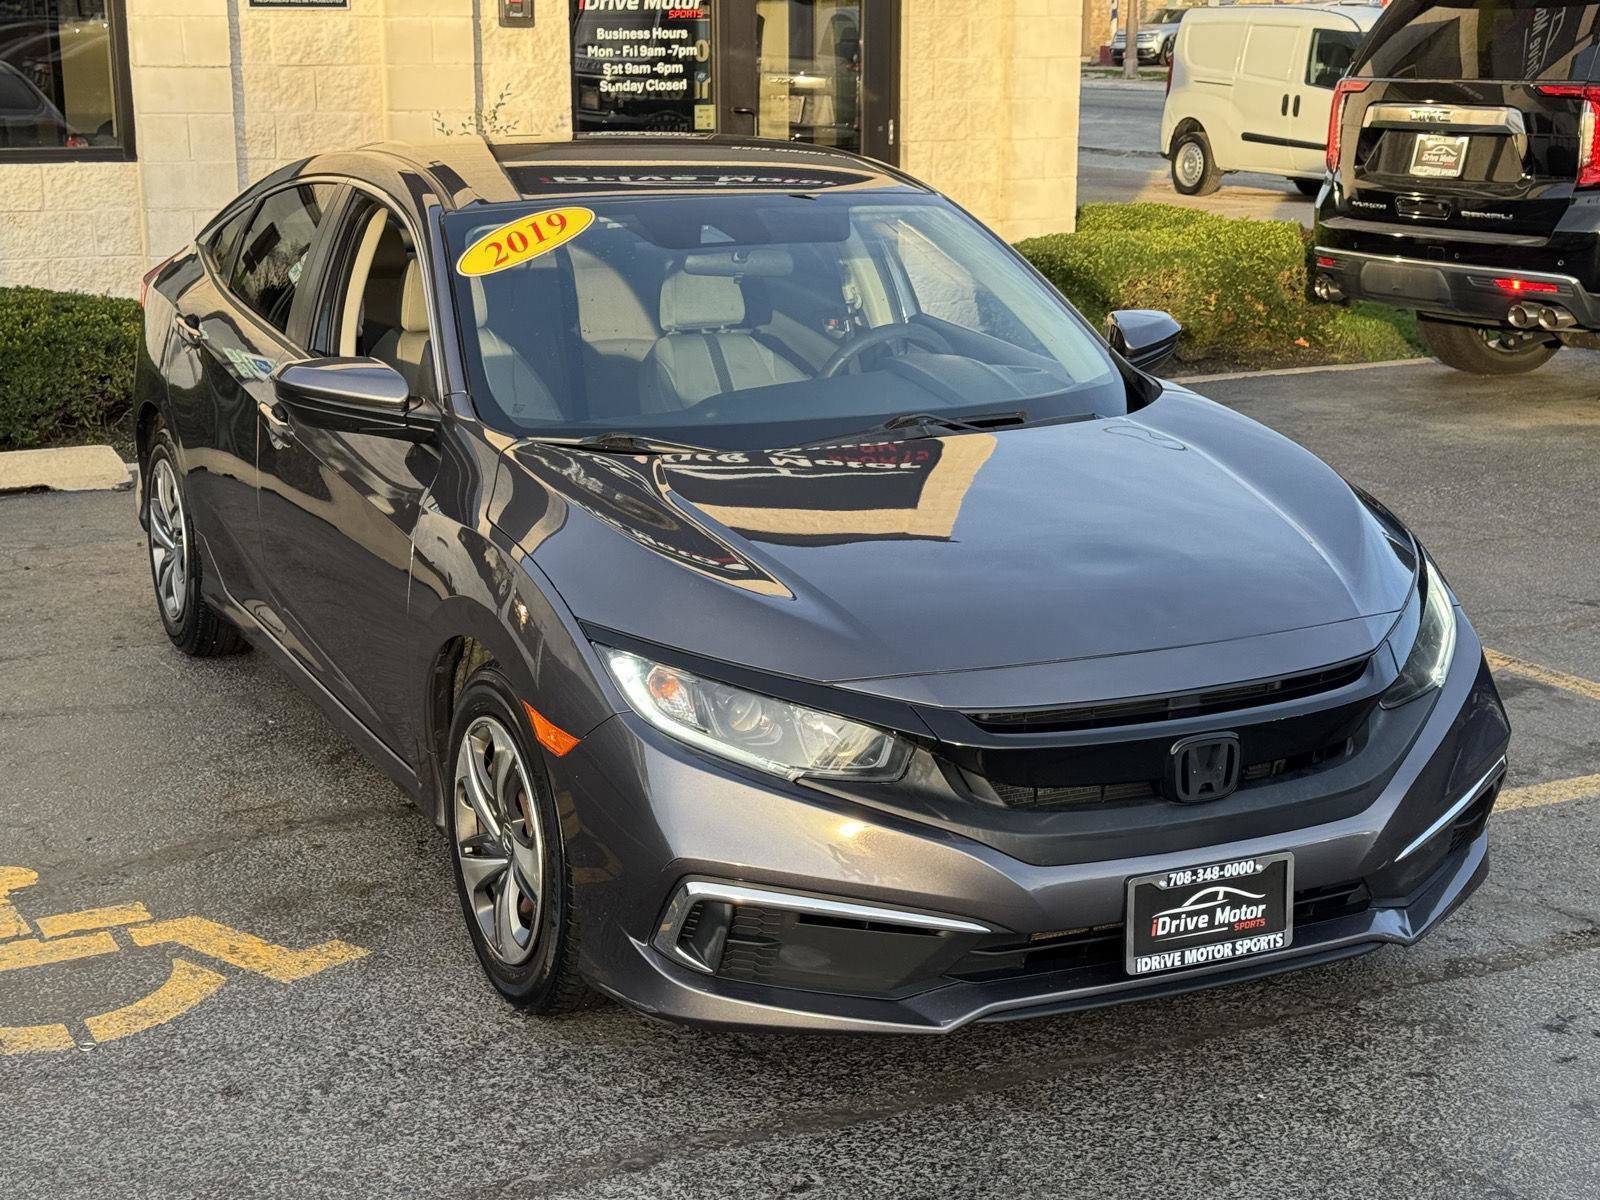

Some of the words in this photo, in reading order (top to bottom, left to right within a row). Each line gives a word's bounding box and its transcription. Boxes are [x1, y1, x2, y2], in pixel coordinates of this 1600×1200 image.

[668, 10, 704, 19] SPORTS
[596, 28, 651, 40] Business
[652, 27, 688, 39] Hours
[587, 45, 613, 57] Mon
[640, 45, 666, 57] 9am
[603, 63, 624, 75] Sat
[625, 63, 651, 74] 9am
[600, 80, 645, 93] Sunday
[646, 79, 687, 91] Closed
[485, 213, 567, 267] 2019
[1168, 861, 1254, 887] 708-348-0000
[1151, 914, 1208, 937] iDrive
[1214, 904, 1267, 926] Motor
[1233, 918, 1266, 932] SPORTS
[1184, 943, 1233, 965] MOTOR
[1235, 933, 1284, 955] SPORTS
